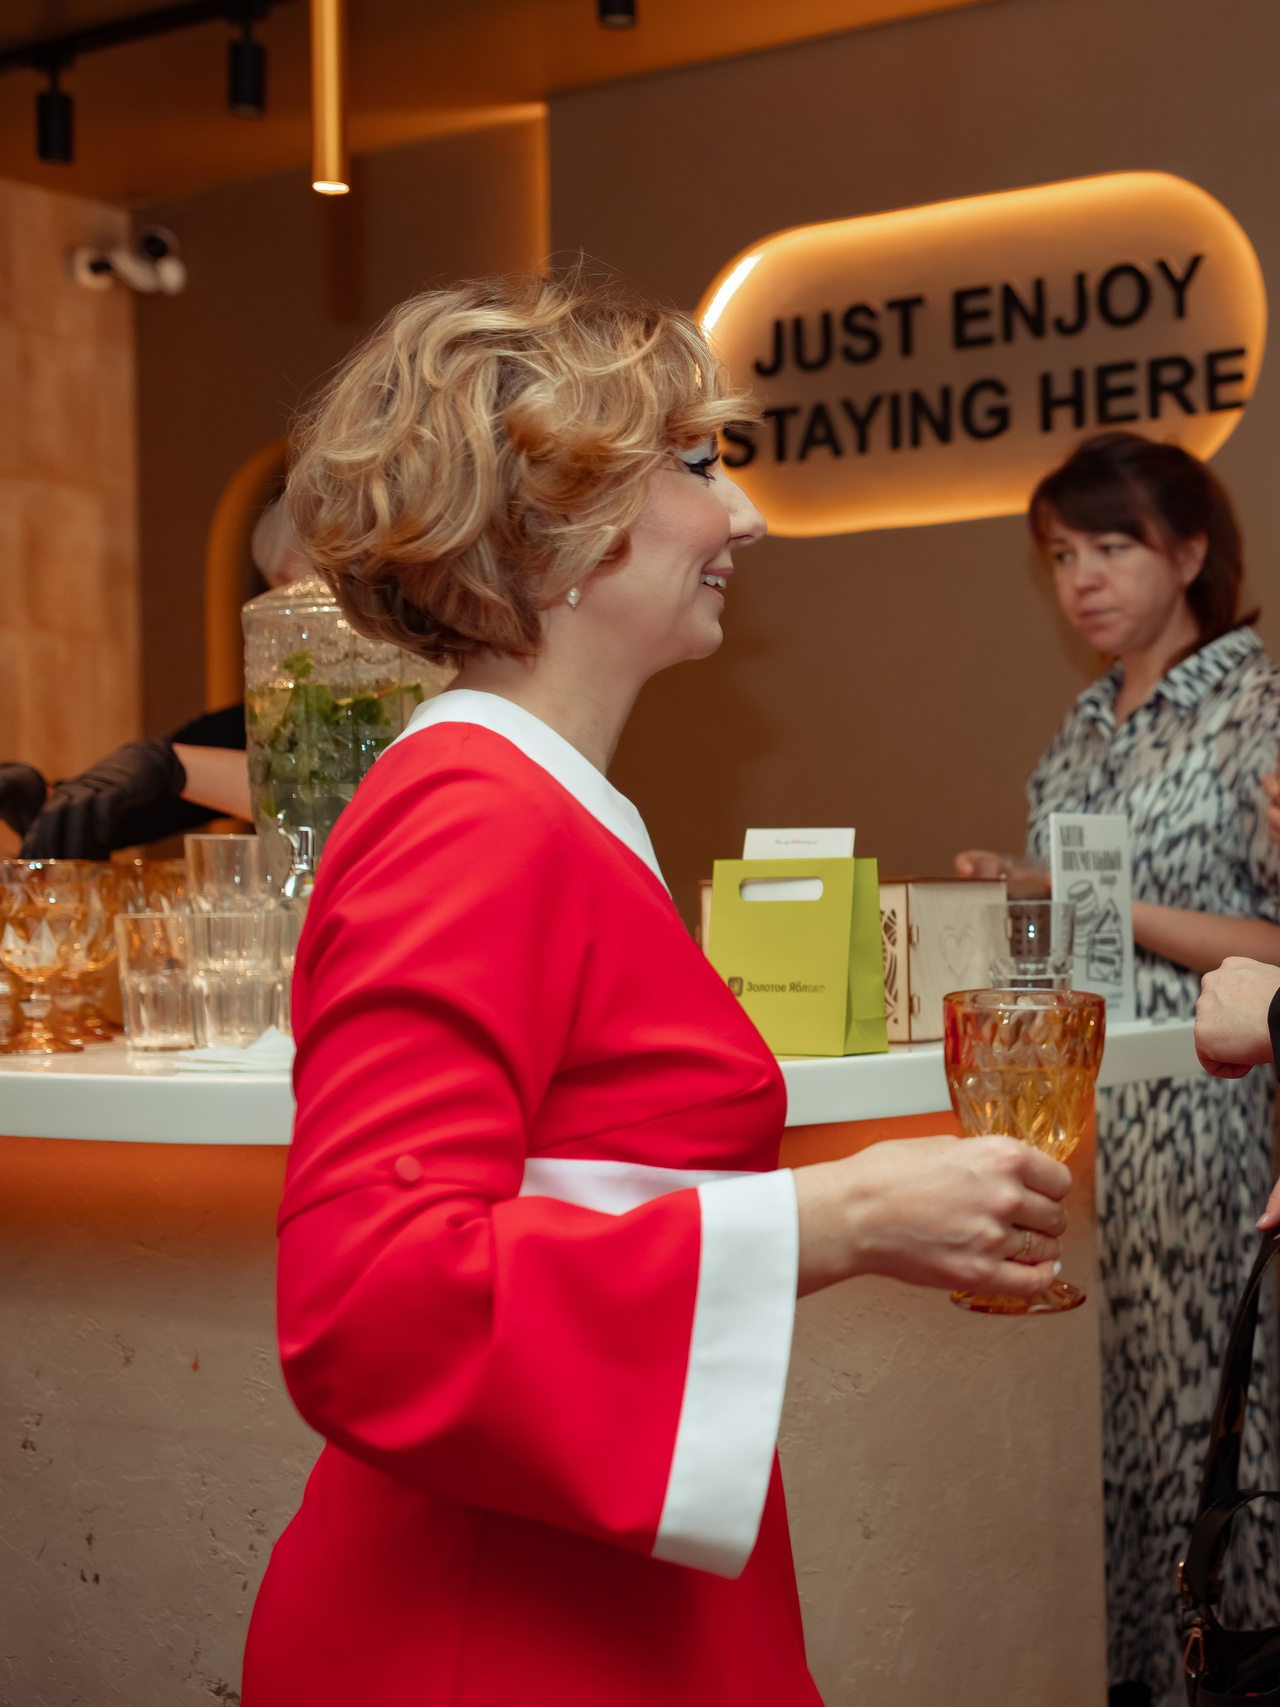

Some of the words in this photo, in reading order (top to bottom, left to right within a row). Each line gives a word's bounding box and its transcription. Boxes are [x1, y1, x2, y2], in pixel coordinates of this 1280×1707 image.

[753, 295, 926, 378] JUST
[952, 254, 1206, 350] ENJOY
[721, 377, 1010, 469] STAYING
[1038, 346, 1248, 433] HERE
[746, 980, 787, 994] Золотое
[788, 979, 826, 994] Яблоко
